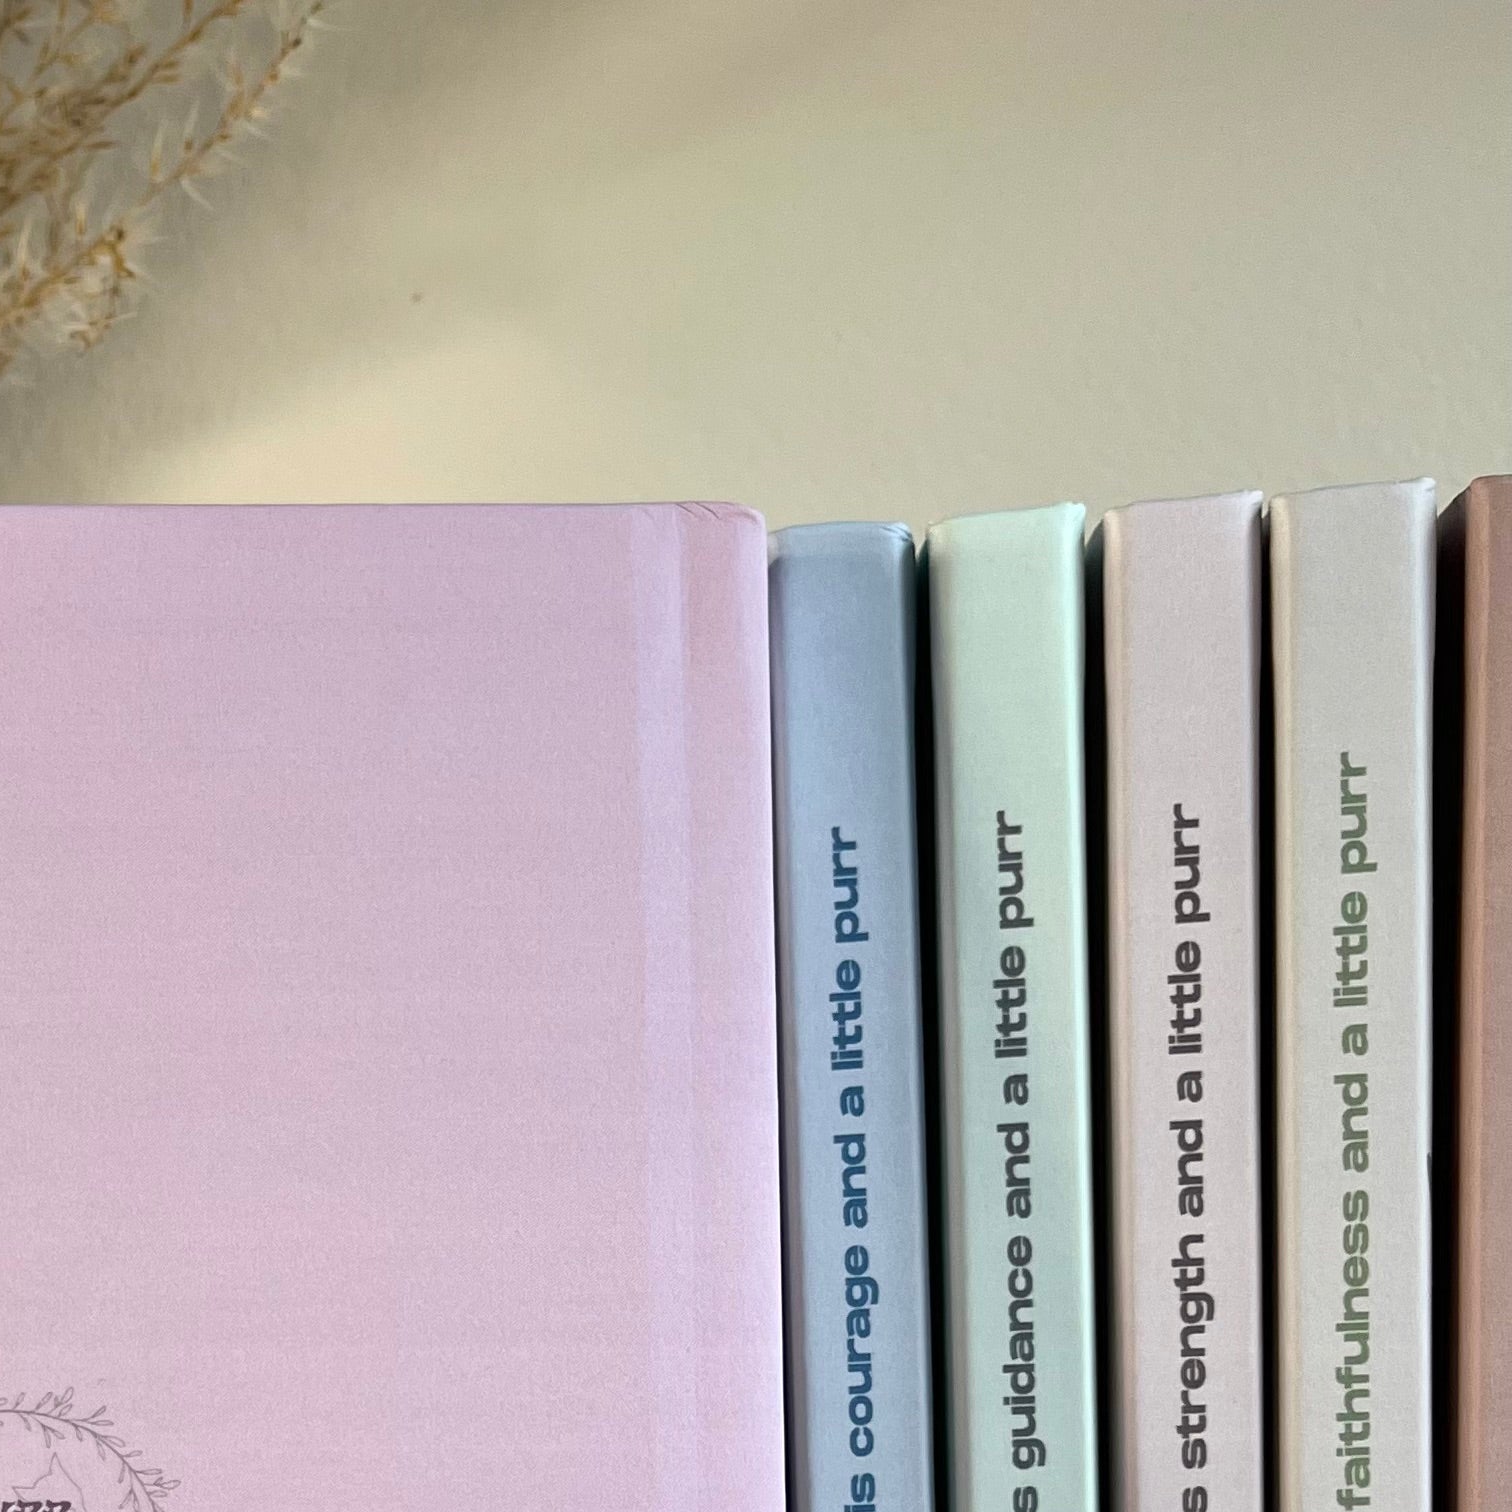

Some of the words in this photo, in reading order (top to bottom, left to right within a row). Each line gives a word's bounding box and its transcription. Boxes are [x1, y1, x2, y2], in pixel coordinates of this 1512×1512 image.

[996, 810, 1035, 930] purr
[1173, 803, 1211, 924] purr
[1340, 751, 1378, 875] purr
[831, 826, 870, 944] purr
[992, 945, 1028, 1059] little
[1167, 940, 1203, 1055] little
[1332, 891, 1368, 1008] little
[828, 959, 864, 1071] little
[1341, 1023, 1369, 1056] a
[839, 1085, 865, 1117] a
[1003, 1073, 1029, 1106] a
[1176, 1070, 1203, 1103] a
[1333, 1073, 1369, 1173] and
[833, 1133, 869, 1229] and
[996, 1121, 1032, 1219] and
[1169, 1119, 1204, 1218] and
[844, 1244, 880, 1457] courage
[1002, 1235, 1047, 1470] guidance
[1171, 1233, 1215, 1470] strength
[1335, 1189, 1371, 1512] faithfulness
